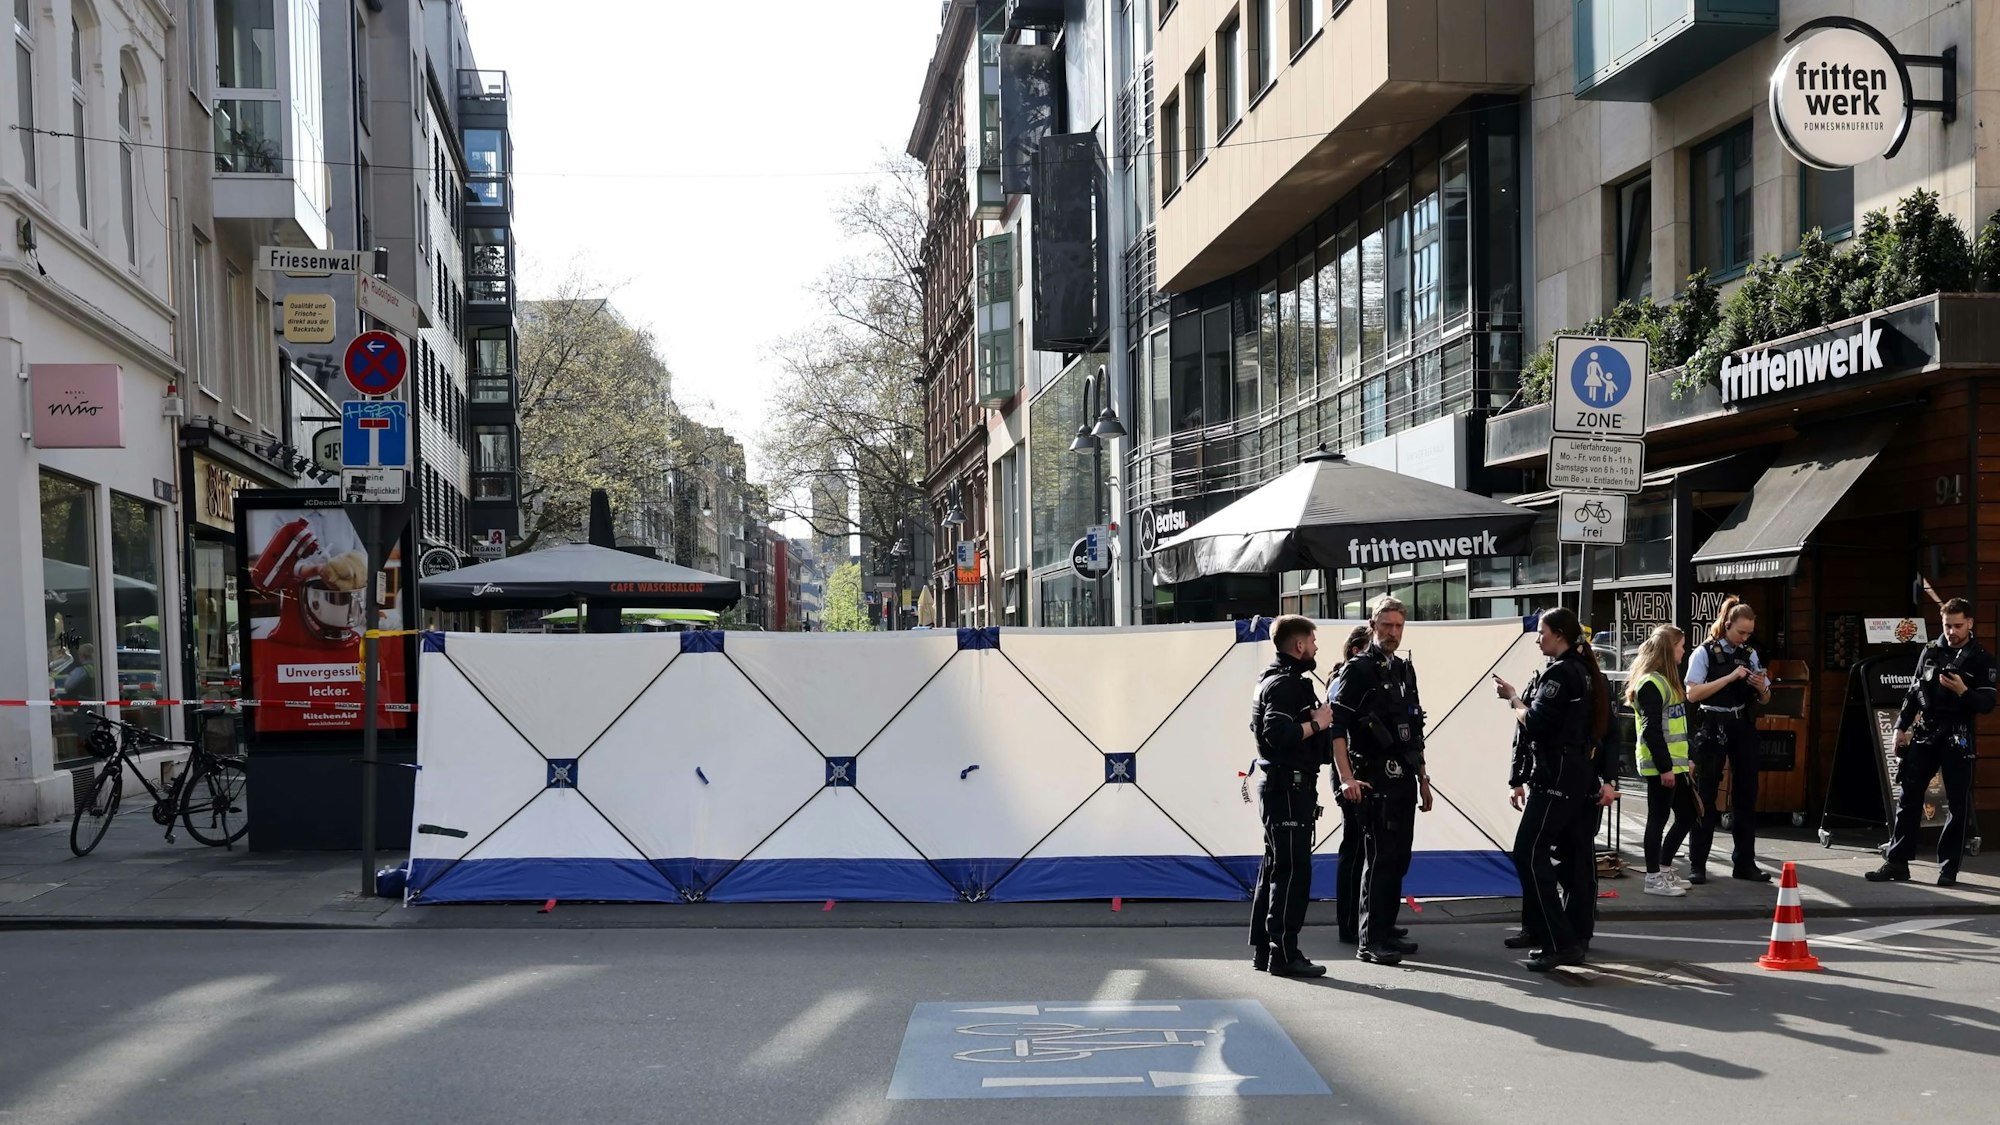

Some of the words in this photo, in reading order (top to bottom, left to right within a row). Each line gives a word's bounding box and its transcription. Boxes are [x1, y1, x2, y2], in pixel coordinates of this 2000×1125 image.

[1796, 61, 1887, 90] fritten
[1805, 84, 1880, 116] werk
[1804, 121, 1884, 131] POMMESMANUFAKTUR
[271, 250, 360, 271] Friesenwall
[1719, 317, 1884, 404] frittenwerk
[1576, 412, 1622, 429] ZONE
[1570, 441, 1622, 453] Lieferfahrzeuge
[1560, 452, 1572, 461] Mo.
[1578, 453, 1587, 462] Fr.
[1608, 455, 1613, 463] h
[1555, 463, 1588, 473] Samstags
[1609, 466, 1614, 474] h
[1620, 467, 1628, 475] 10
[1570, 474, 1580, 483] Be
[1594, 475, 1622, 486] Entladen
[1624, 479, 1636, 487] frei
[1582, 526, 1603, 538] frei
[1348, 530, 1498, 565] frittenwerk
[1715, 560, 1780, 575] POMMESMANUFAKTUR
[610, 582, 634, 593] CAFE
[637, 582, 703, 593] WASCHSALON
[286, 666, 359, 680] Unvergessli
[309, 685, 350, 697] lecker.
[303, 712, 357, 720] KitchenAid
